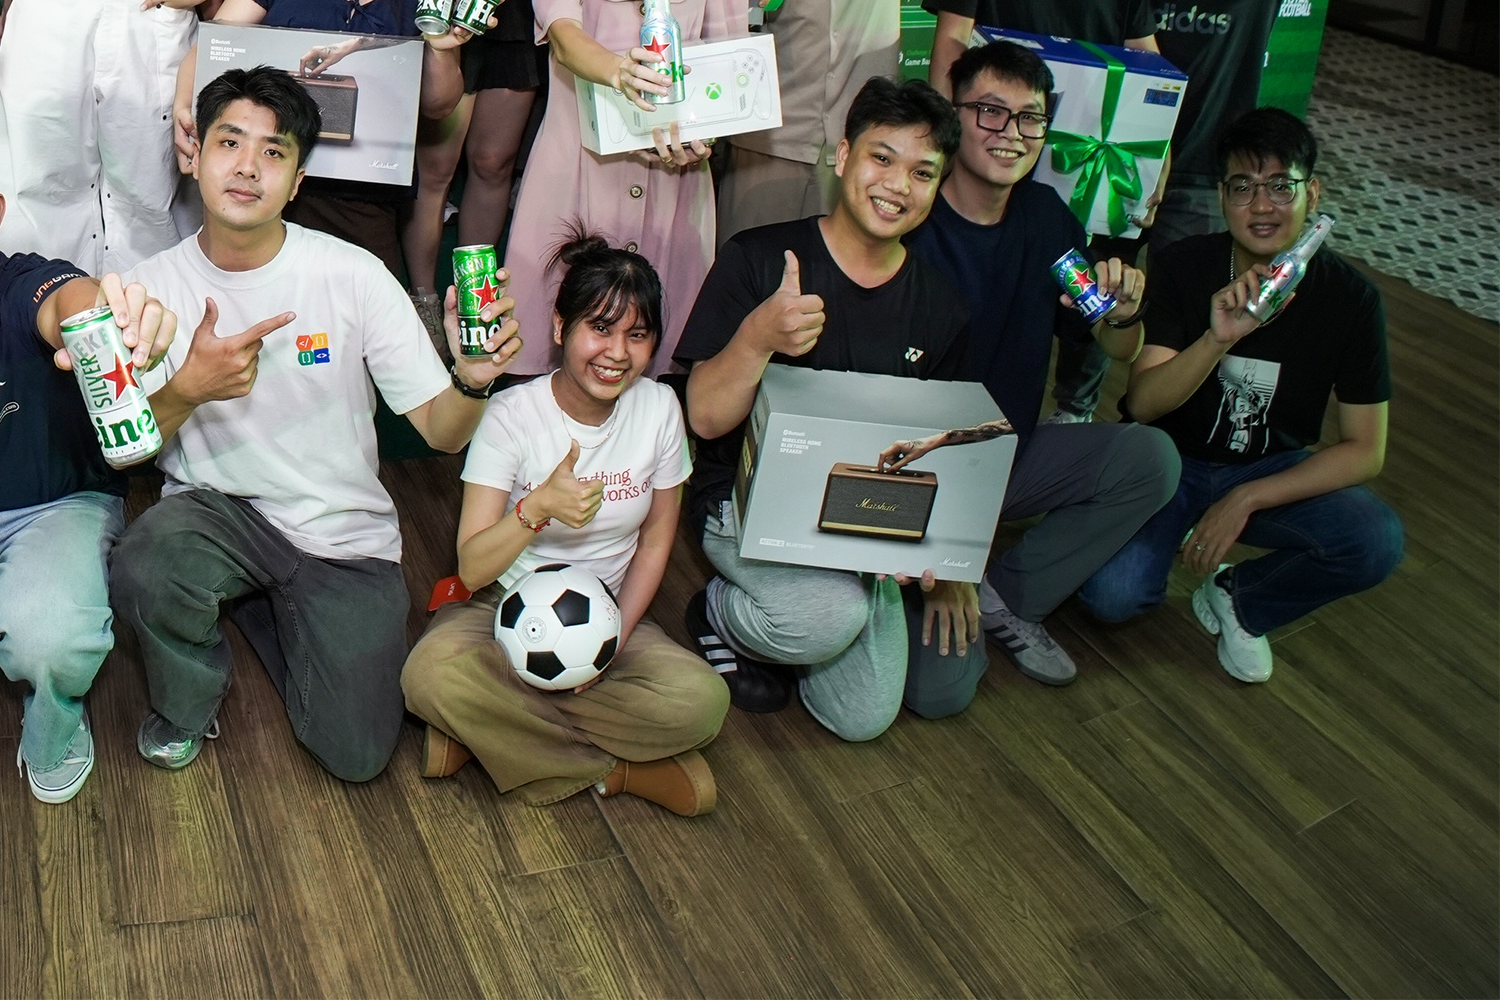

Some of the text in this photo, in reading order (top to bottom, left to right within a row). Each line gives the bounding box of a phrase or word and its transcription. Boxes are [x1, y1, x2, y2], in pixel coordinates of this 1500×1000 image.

[1152, 1, 1232, 35] didas
[368, 159, 399, 170] Marshall
[79, 354, 113, 409] SILVER
[855, 497, 899, 512] Marshall
[939, 557, 971, 568] Marshall
